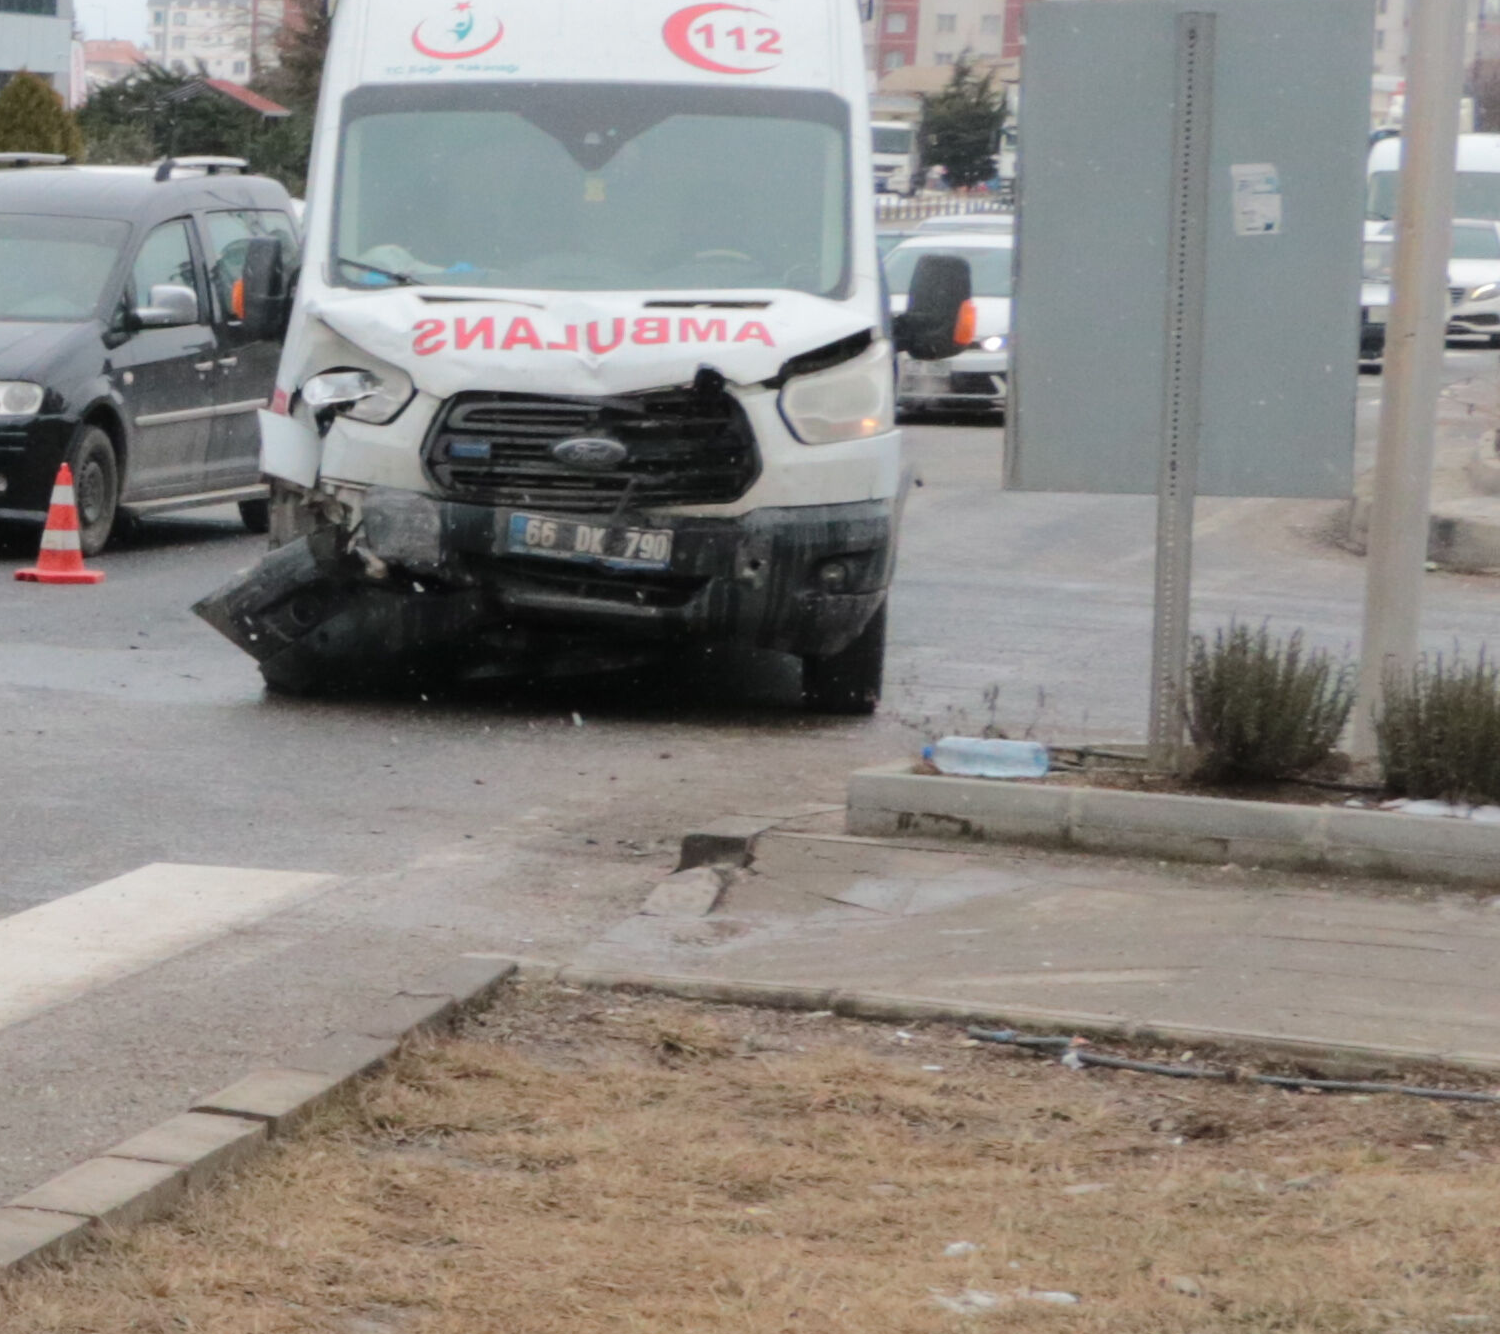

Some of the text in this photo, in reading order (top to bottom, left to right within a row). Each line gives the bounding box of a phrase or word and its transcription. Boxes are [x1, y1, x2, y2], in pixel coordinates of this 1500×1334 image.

[694, 23, 783, 55] 112
[525, 519, 669, 560] 66 DK 790
